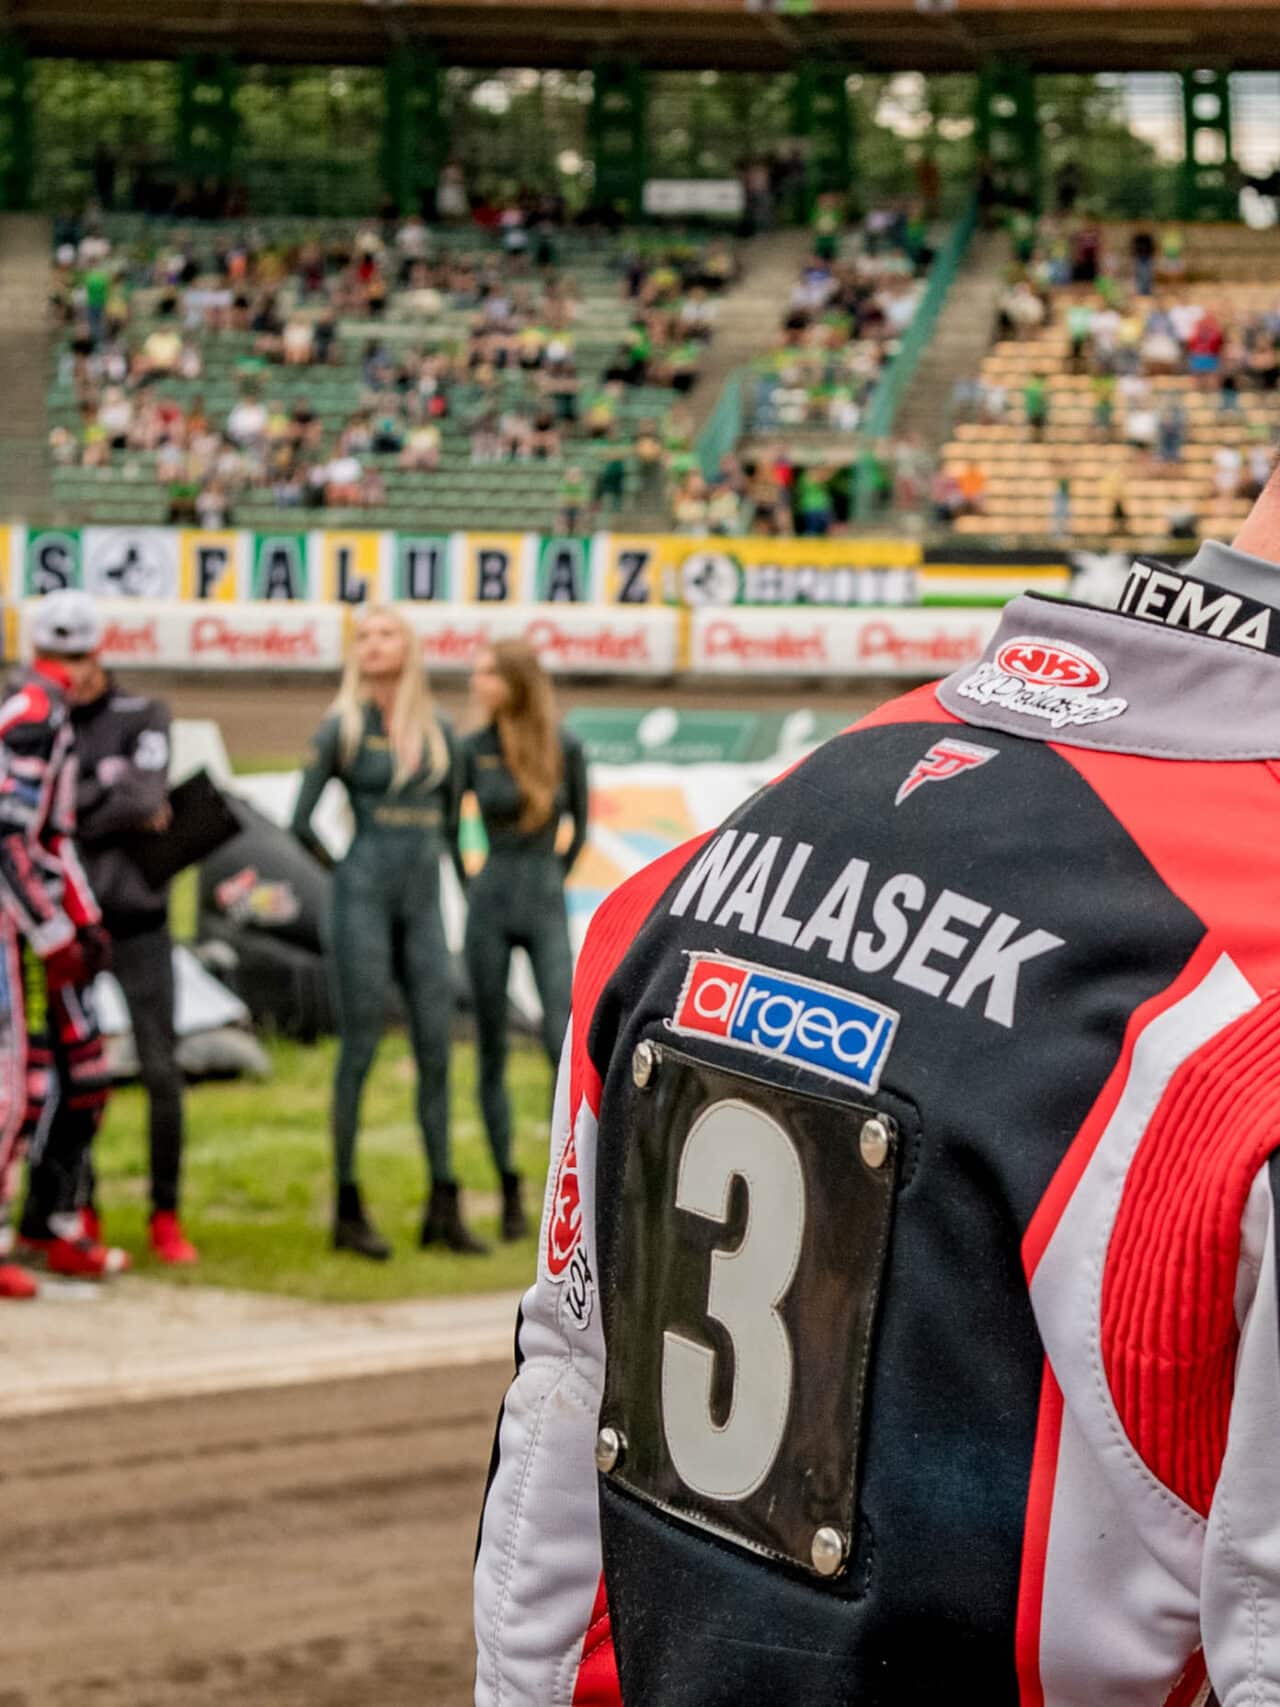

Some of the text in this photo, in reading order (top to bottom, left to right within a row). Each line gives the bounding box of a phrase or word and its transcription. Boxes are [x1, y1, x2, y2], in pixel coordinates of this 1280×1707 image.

[196, 547, 652, 603] FALUBAZ
[669, 829, 1067, 1028] WALASEK
[693, 976, 893, 1070] arged
[662, 1098, 806, 1501] 3
